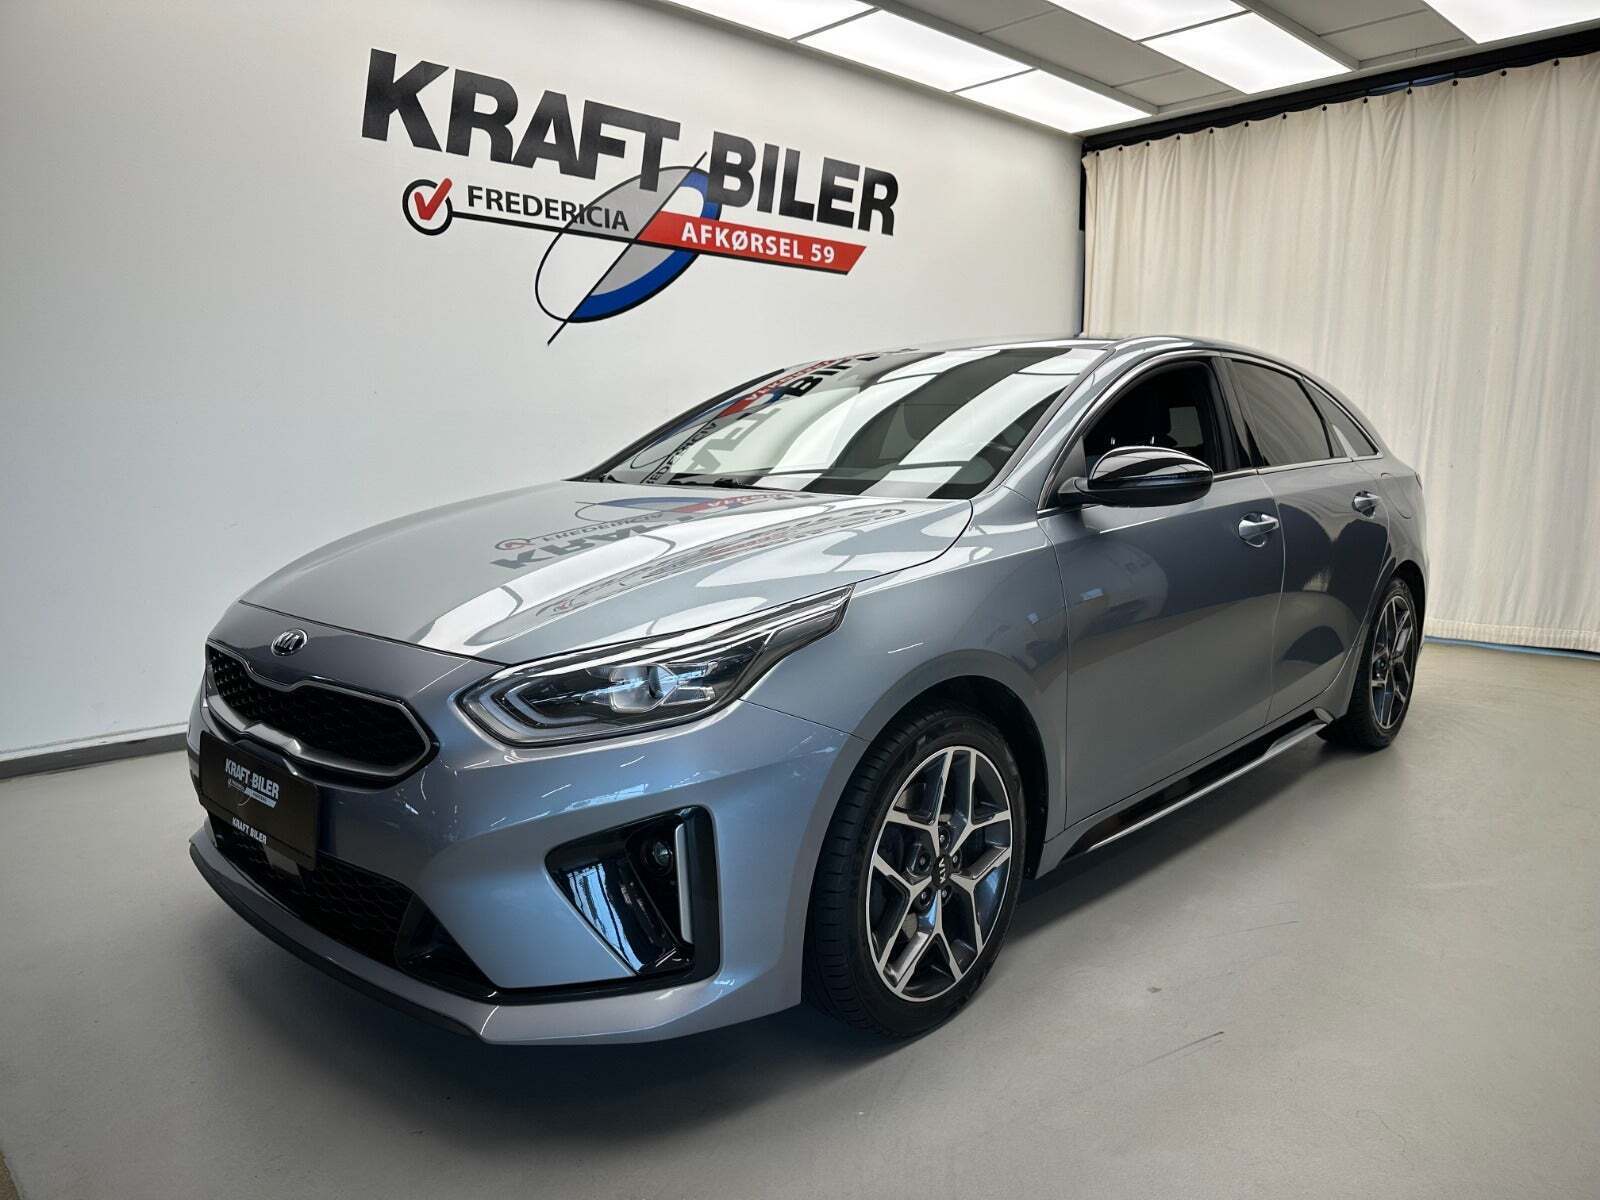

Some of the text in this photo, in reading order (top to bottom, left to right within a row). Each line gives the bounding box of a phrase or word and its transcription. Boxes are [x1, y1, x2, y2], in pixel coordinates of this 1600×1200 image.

[361, 48, 899, 236] KRAFT BILER
[467, 185, 630, 232] FREDERICIA
[681, 221, 835, 264] AFKØRSEL 59
[225, 757, 251, 785] KRAFT
[251, 772, 280, 800] BILER
[232, 817, 267, 845] KRAFT BILER
